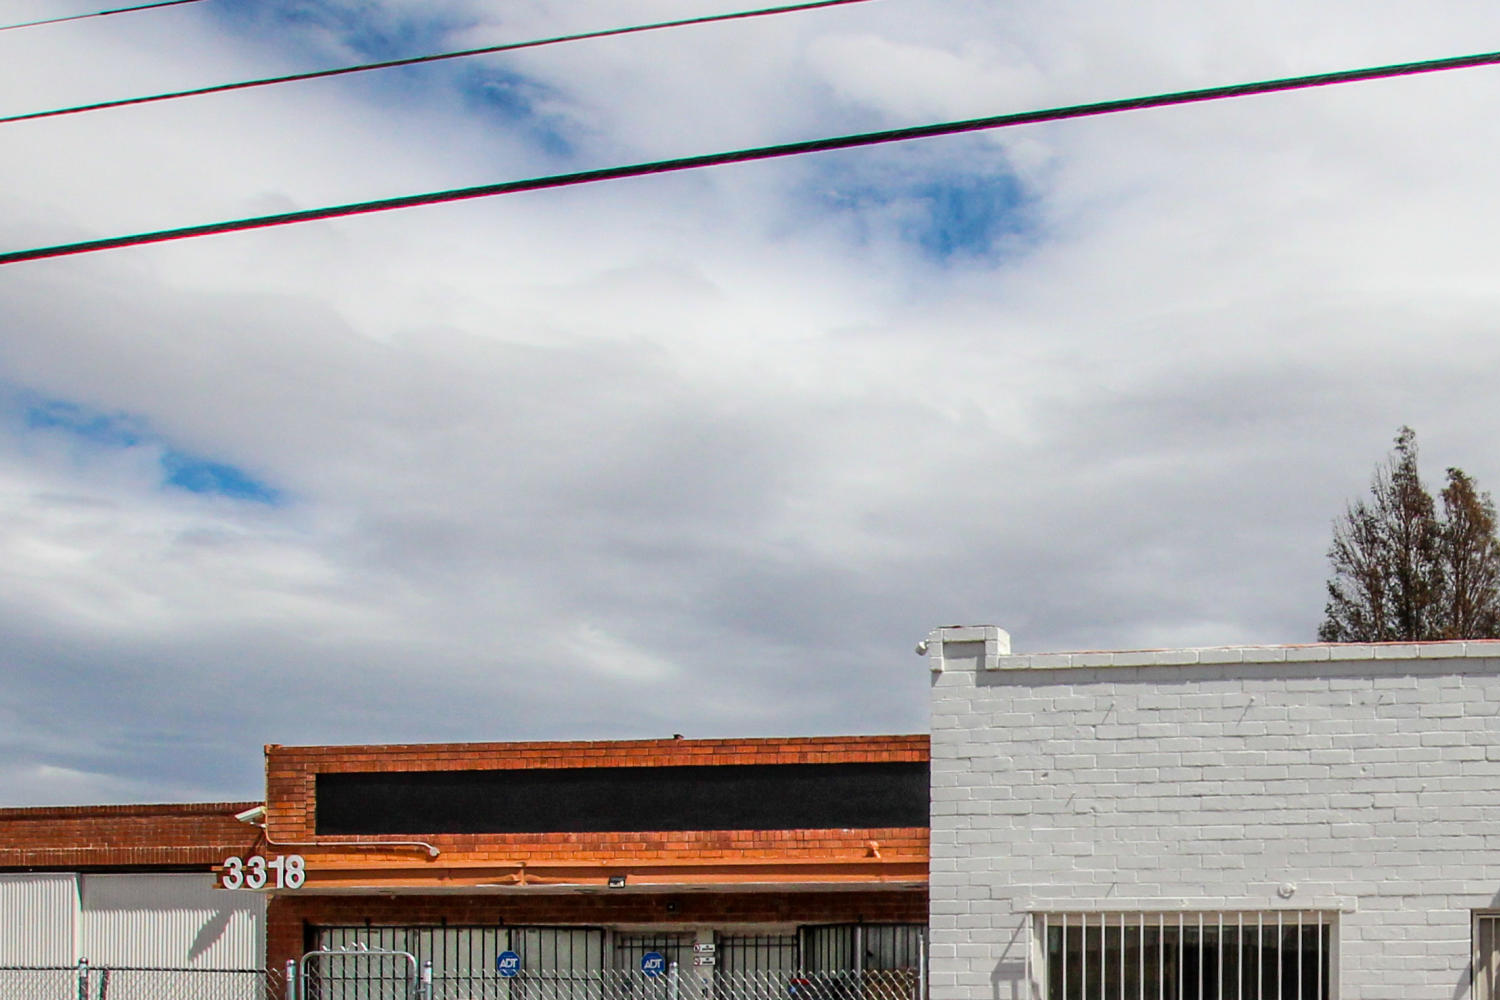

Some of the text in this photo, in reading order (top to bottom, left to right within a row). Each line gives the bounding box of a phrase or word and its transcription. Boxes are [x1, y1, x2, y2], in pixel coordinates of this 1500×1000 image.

[222, 854, 306, 890] 3318
[499, 958, 518, 968] ADT
[643, 959, 662, 969] ADT
